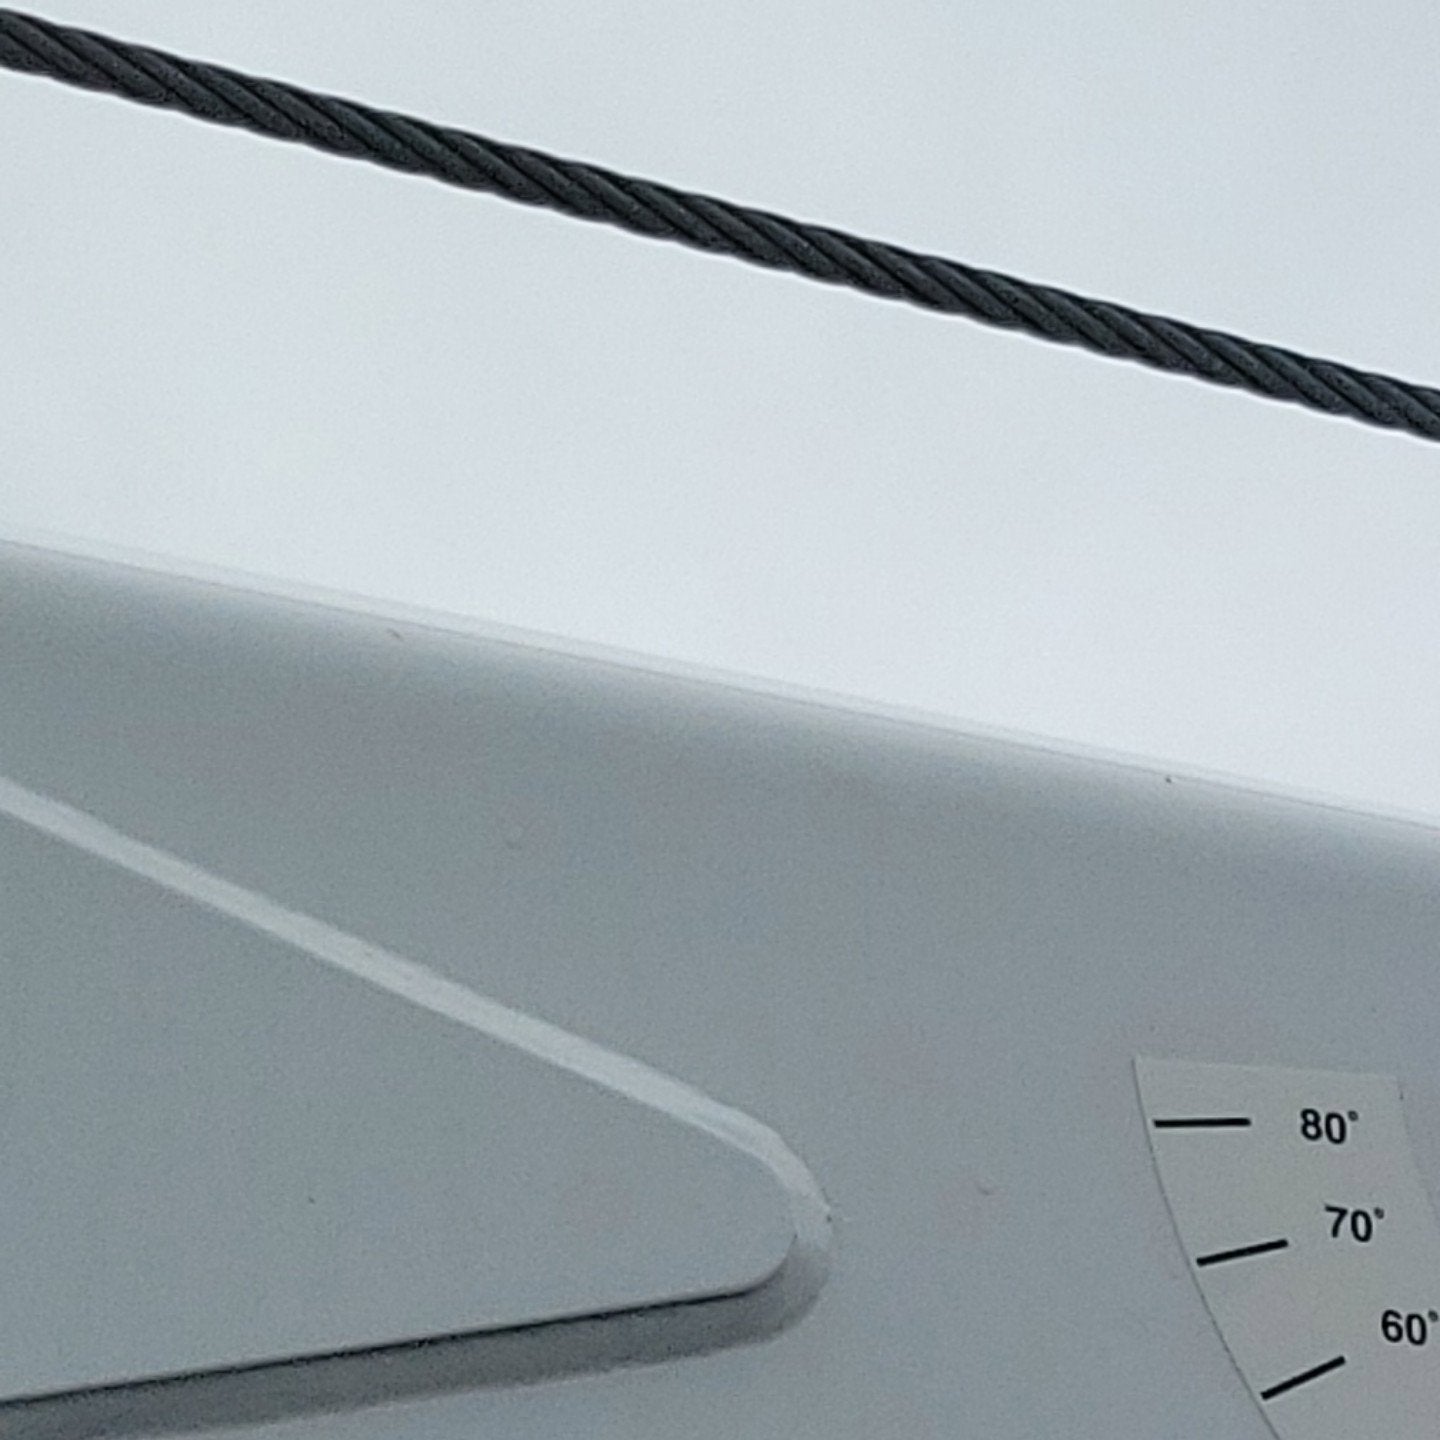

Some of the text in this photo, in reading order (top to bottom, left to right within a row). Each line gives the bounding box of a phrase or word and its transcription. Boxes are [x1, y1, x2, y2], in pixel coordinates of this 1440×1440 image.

[1299, 1107, 1359, 1146] 80°
[1324, 1204, 1385, 1243] 70°
[1380, 1308, 1439, 1347] 60°
